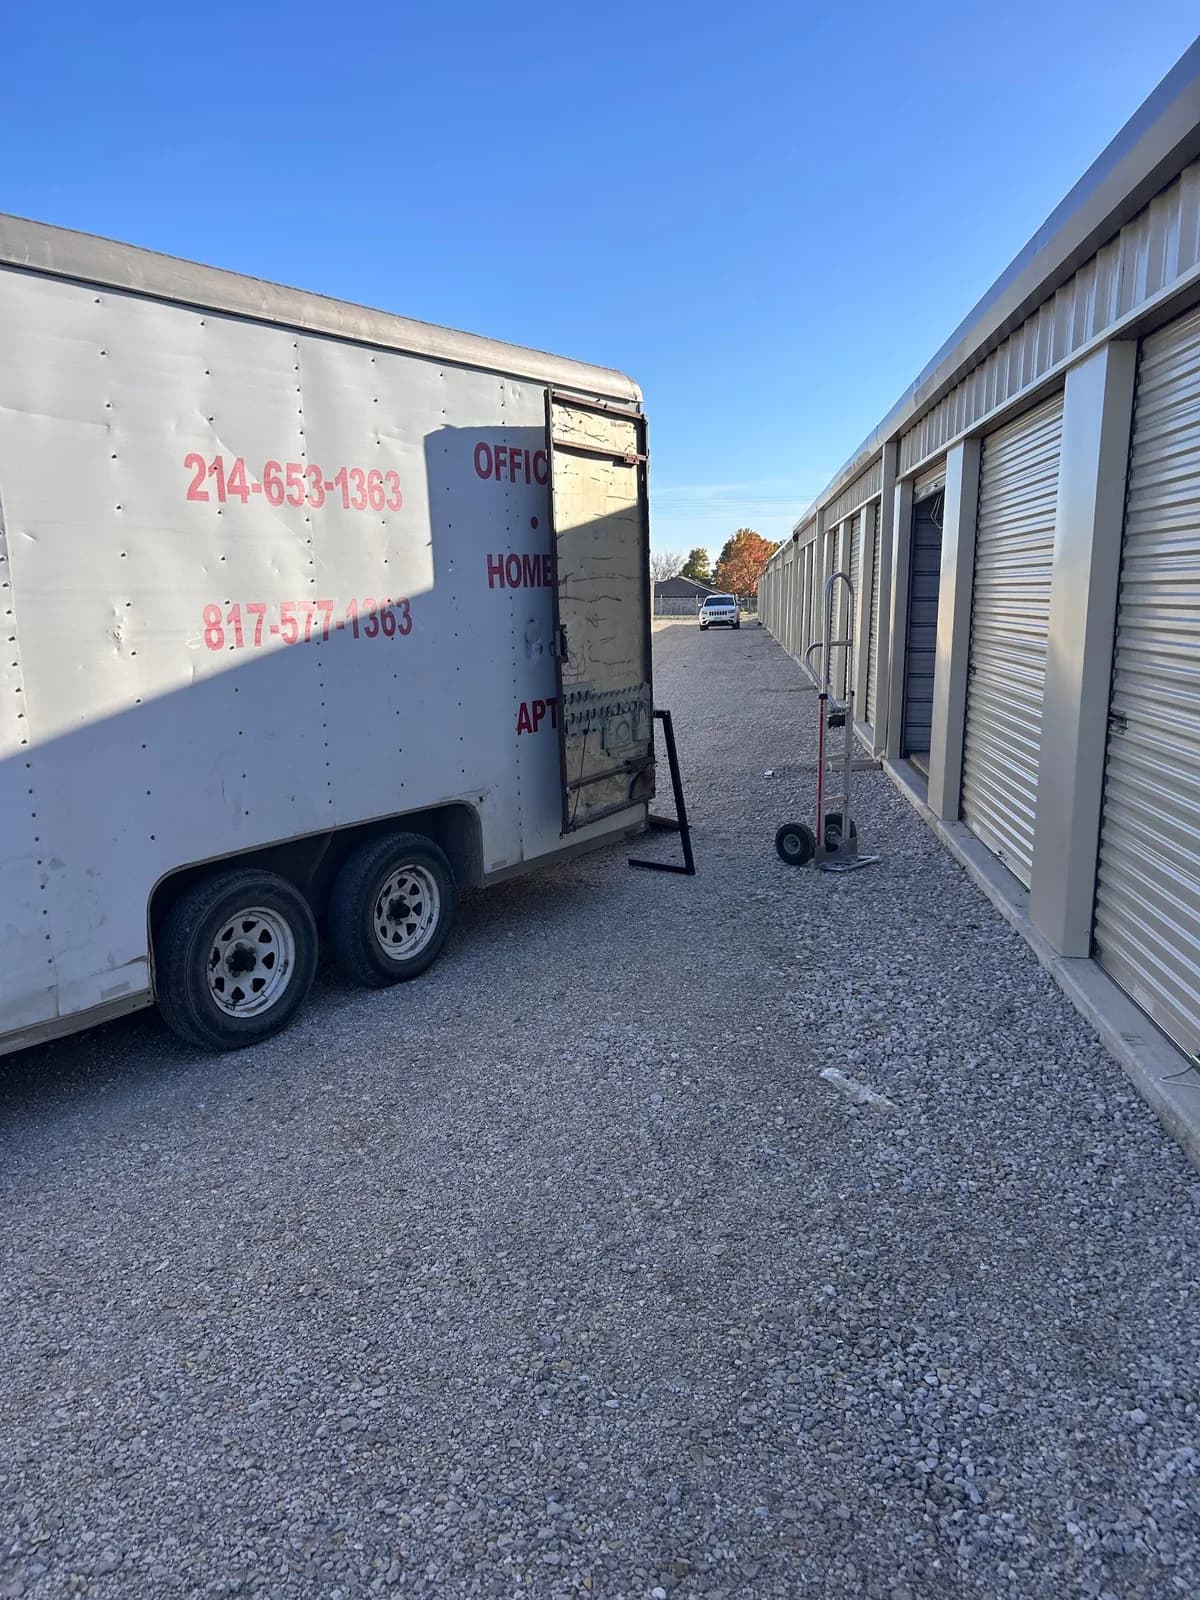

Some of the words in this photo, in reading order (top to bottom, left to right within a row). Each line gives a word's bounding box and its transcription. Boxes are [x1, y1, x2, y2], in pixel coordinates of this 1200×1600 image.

[184, 453, 403, 511] 214-653-1363
[474, 442, 550, 485] OFFIC
[487, 553, 554, 589] HOME
[203, 597, 412, 651] 817-577-1363
[516, 697, 560, 736] APT
